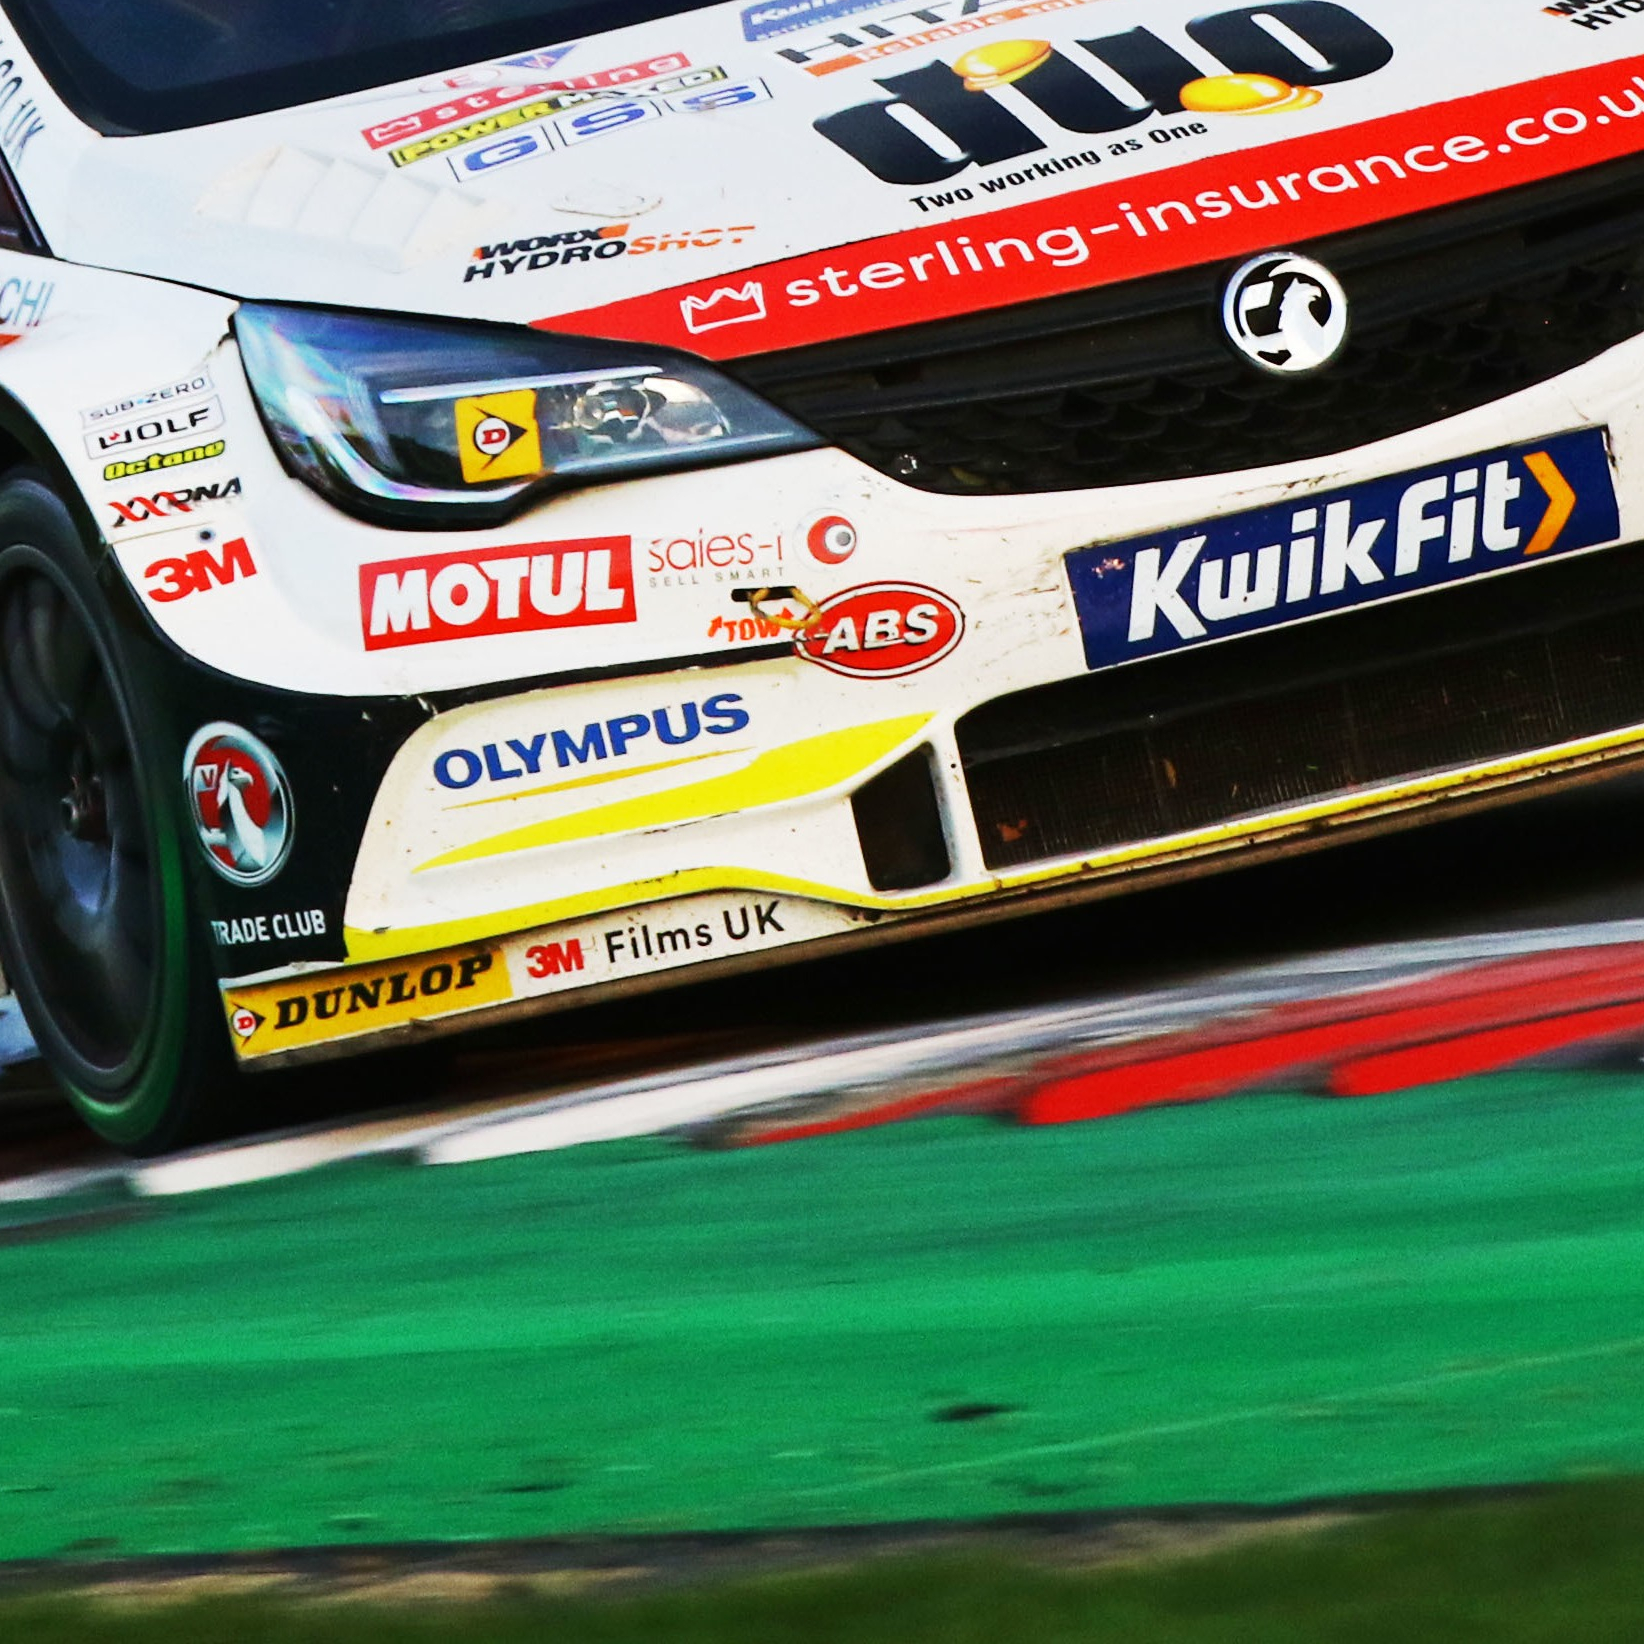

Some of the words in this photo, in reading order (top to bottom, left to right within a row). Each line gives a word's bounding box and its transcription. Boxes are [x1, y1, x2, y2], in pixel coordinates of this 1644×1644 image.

[434, 54, 684, 121] steling
[909, 185, 974, 213] Two
[979, 149, 1102, 192] working
[1108, 137, 1144, 157] as
[1147, 120, 1209, 145] One
[98, 407, 210, 450] WOLF
[103, 439, 226, 481] Octane
[144, 537, 257, 604] 3M
[368, 550, 629, 637] MOTUL
[649, 574, 700, 589] SELL
[714, 567, 786, 583] SMART
[821, 601, 940, 656] ABS
[433, 692, 751, 791] OLYMPUS
[212, 913, 271, 946] TRADE
[272, 908, 327, 940] CLUB
[526, 938, 585, 981] 3M
[605, 919, 713, 965] Films
[723, 900, 786, 942] UK
[275, 951, 495, 1031] DUNLOP
